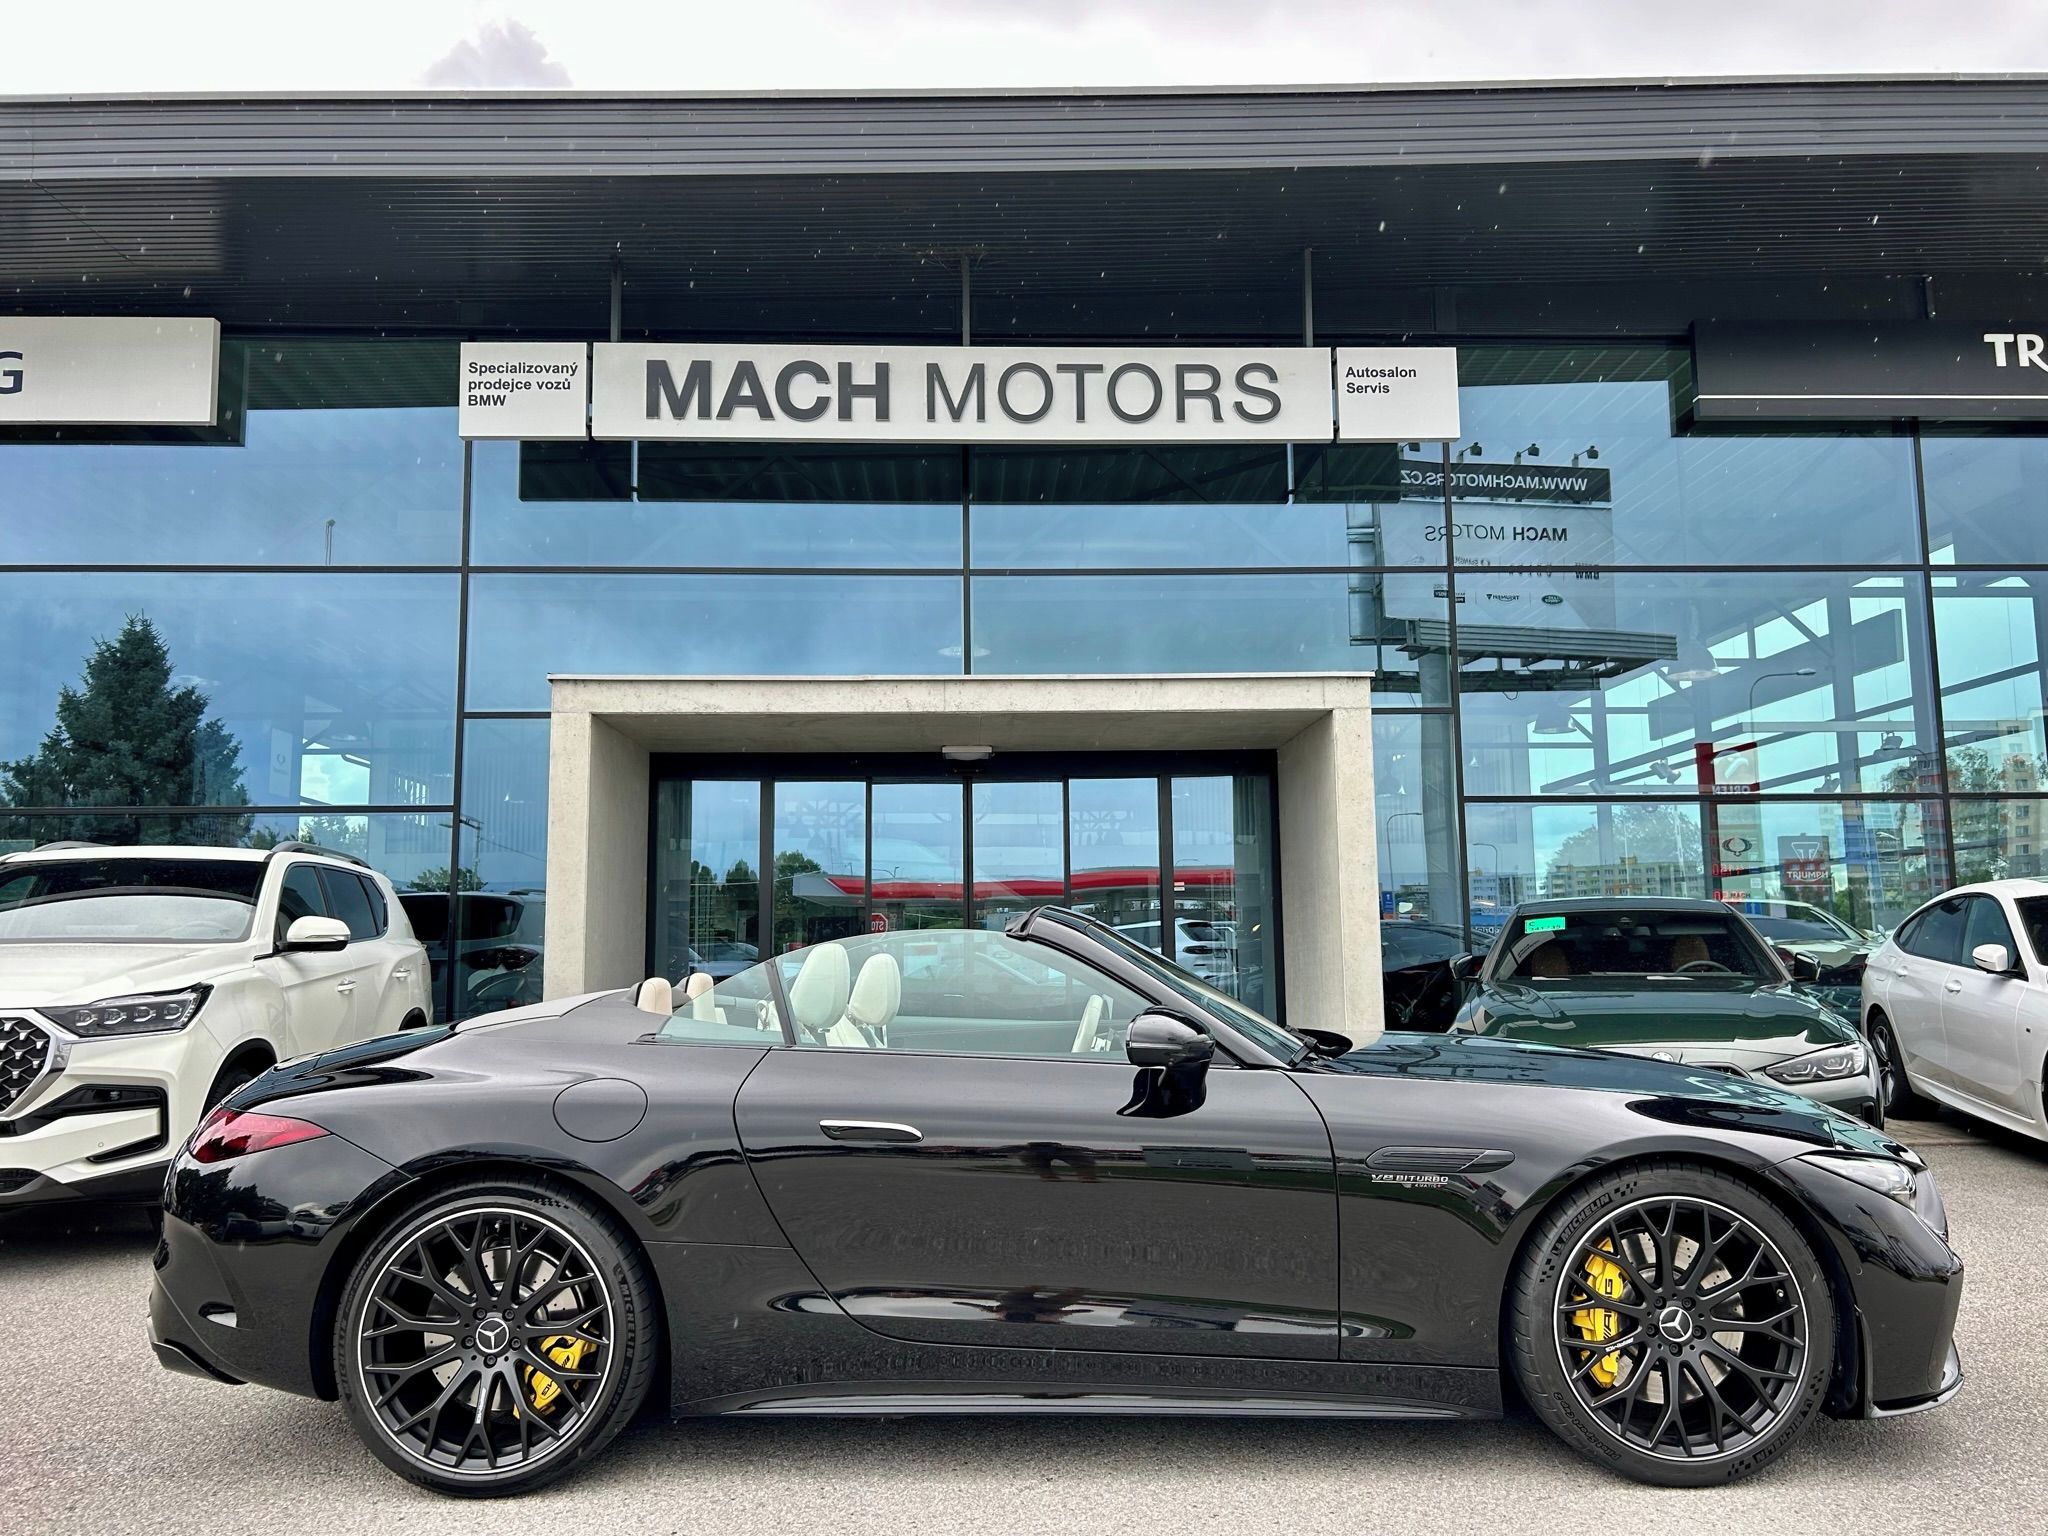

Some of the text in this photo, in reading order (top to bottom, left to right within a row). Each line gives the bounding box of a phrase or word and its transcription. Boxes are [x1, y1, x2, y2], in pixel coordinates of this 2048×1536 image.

[0, 351, 23, 394] G
[468, 361, 578, 377] Specializovaný
[1345, 366, 1417, 379] Autosalon
[468, 377, 571, 392] prodejce vozů
[645, 359, 1282, 424] MACH MOTORS
[1346, 382, 1391, 394] Servis
[468, 394, 506, 407] BMW
[1786, 870, 1829, 880] TRIUMPH
[1563, 1193, 1611, 1239] MICHELIN
[620, 1283, 635, 1358] MICHELIN
